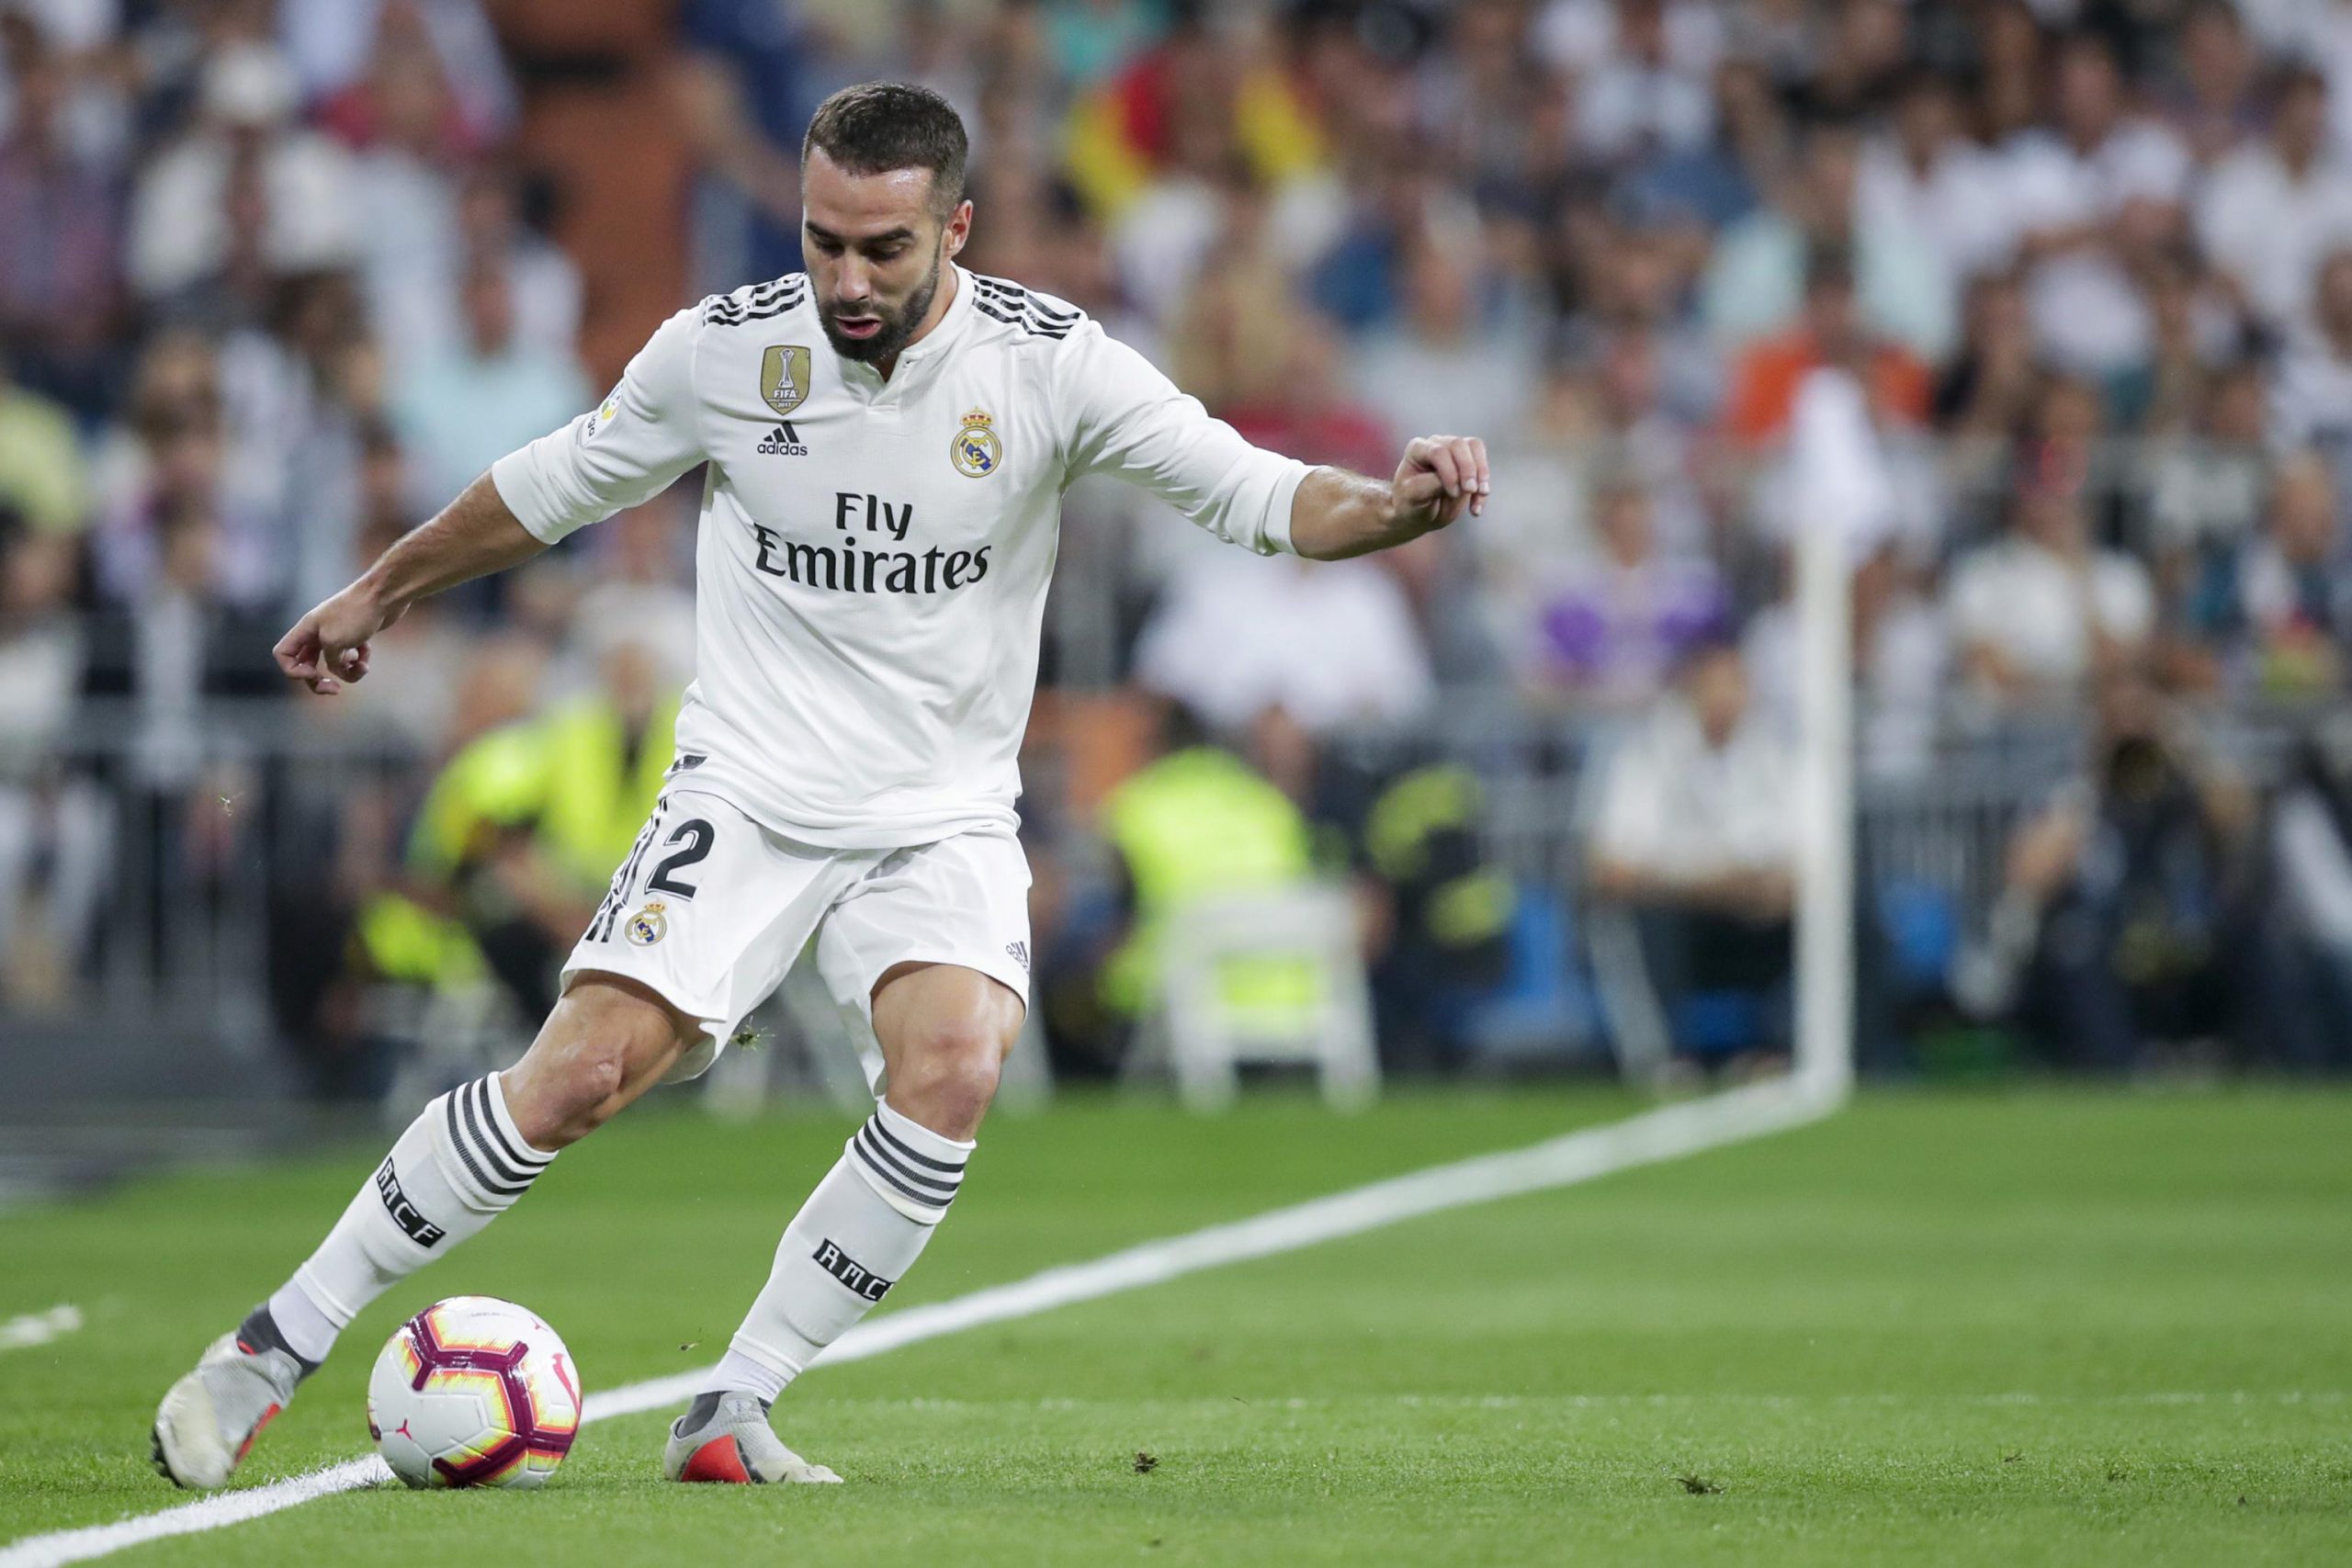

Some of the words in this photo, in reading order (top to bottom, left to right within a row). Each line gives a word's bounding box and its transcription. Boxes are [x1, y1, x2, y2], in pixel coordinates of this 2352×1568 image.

[774, 389, 797, 399] FIFA
[757, 442, 808, 457] adidas
[836, 492, 913, 541] Fly
[753, 522, 992, 594] Emirates
[645, 818, 716, 902] 2
[377, 1159, 442, 1241] RMCF
[818, 1242, 894, 1300] RMC
